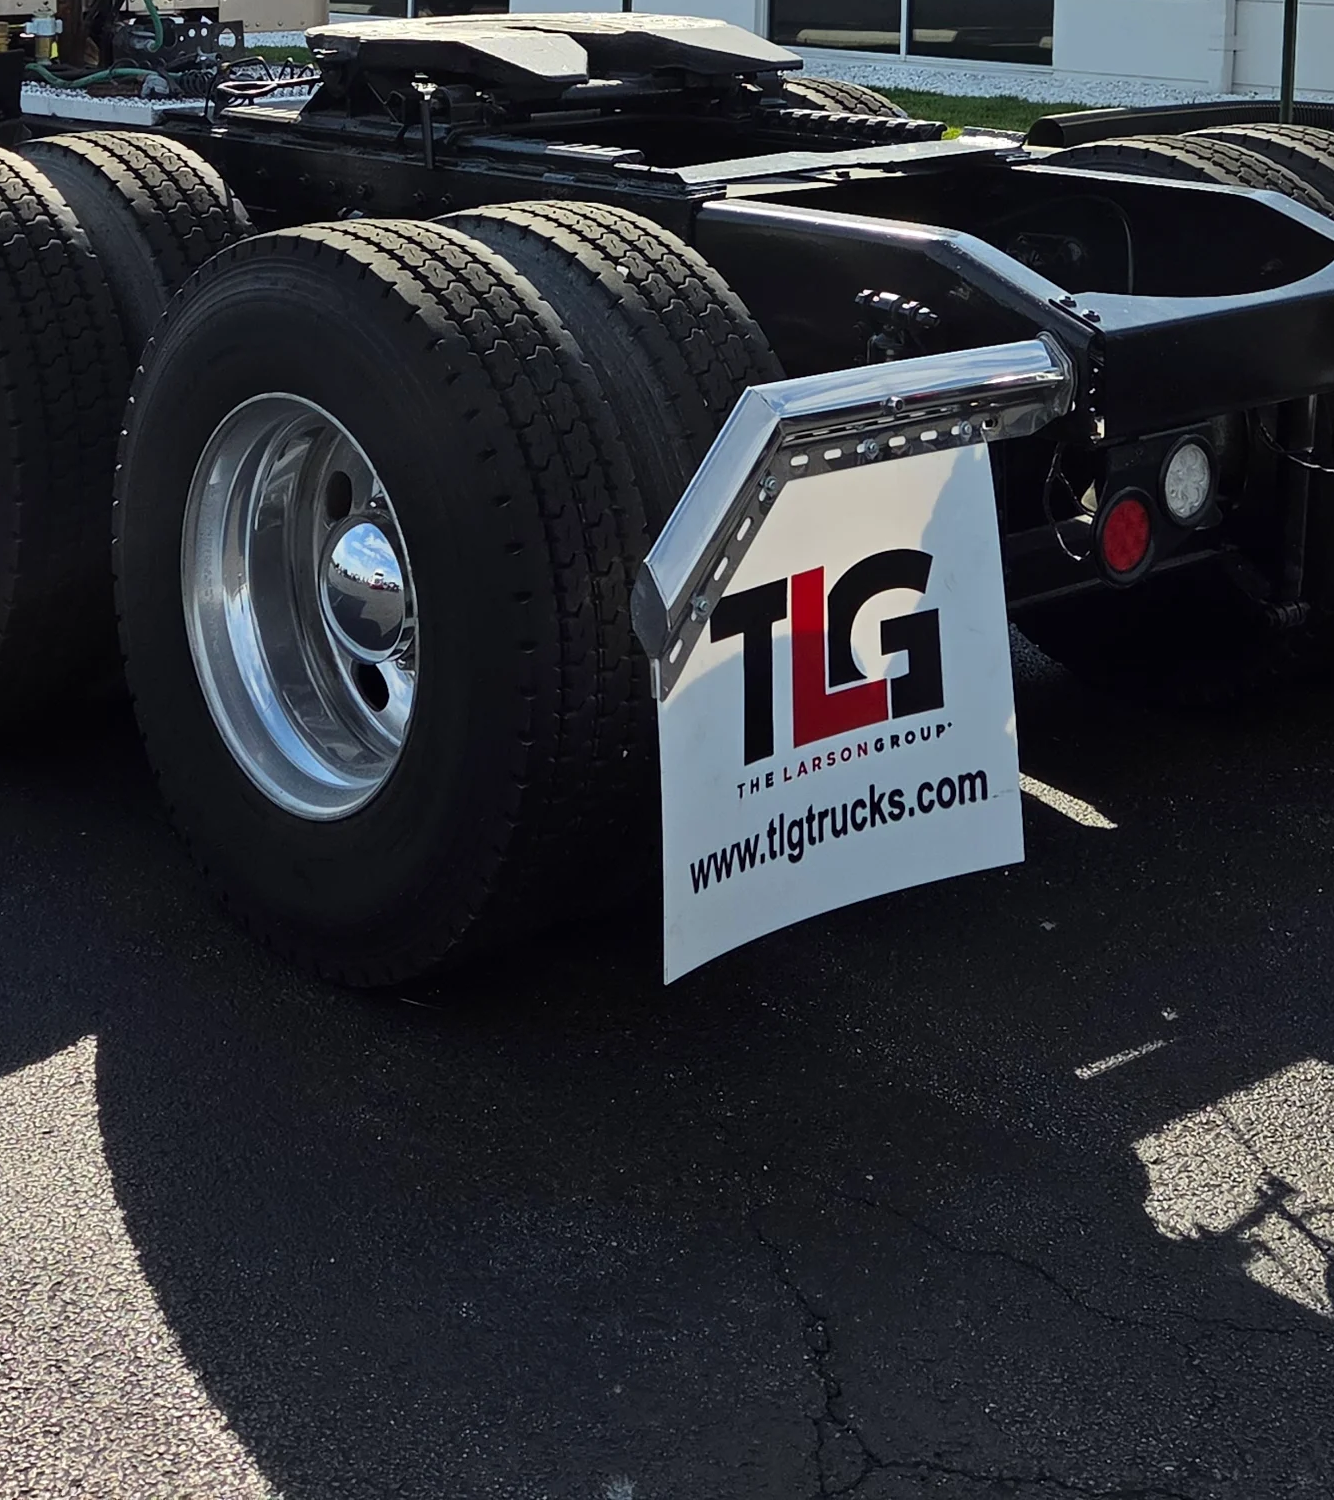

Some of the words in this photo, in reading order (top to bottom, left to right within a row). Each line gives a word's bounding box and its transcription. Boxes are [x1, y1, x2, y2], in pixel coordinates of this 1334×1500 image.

[709, 548, 945, 767] TLG
[689, 769, 989, 895] www.tlgtrucks.com
[737, 771, 774, 799] THE
